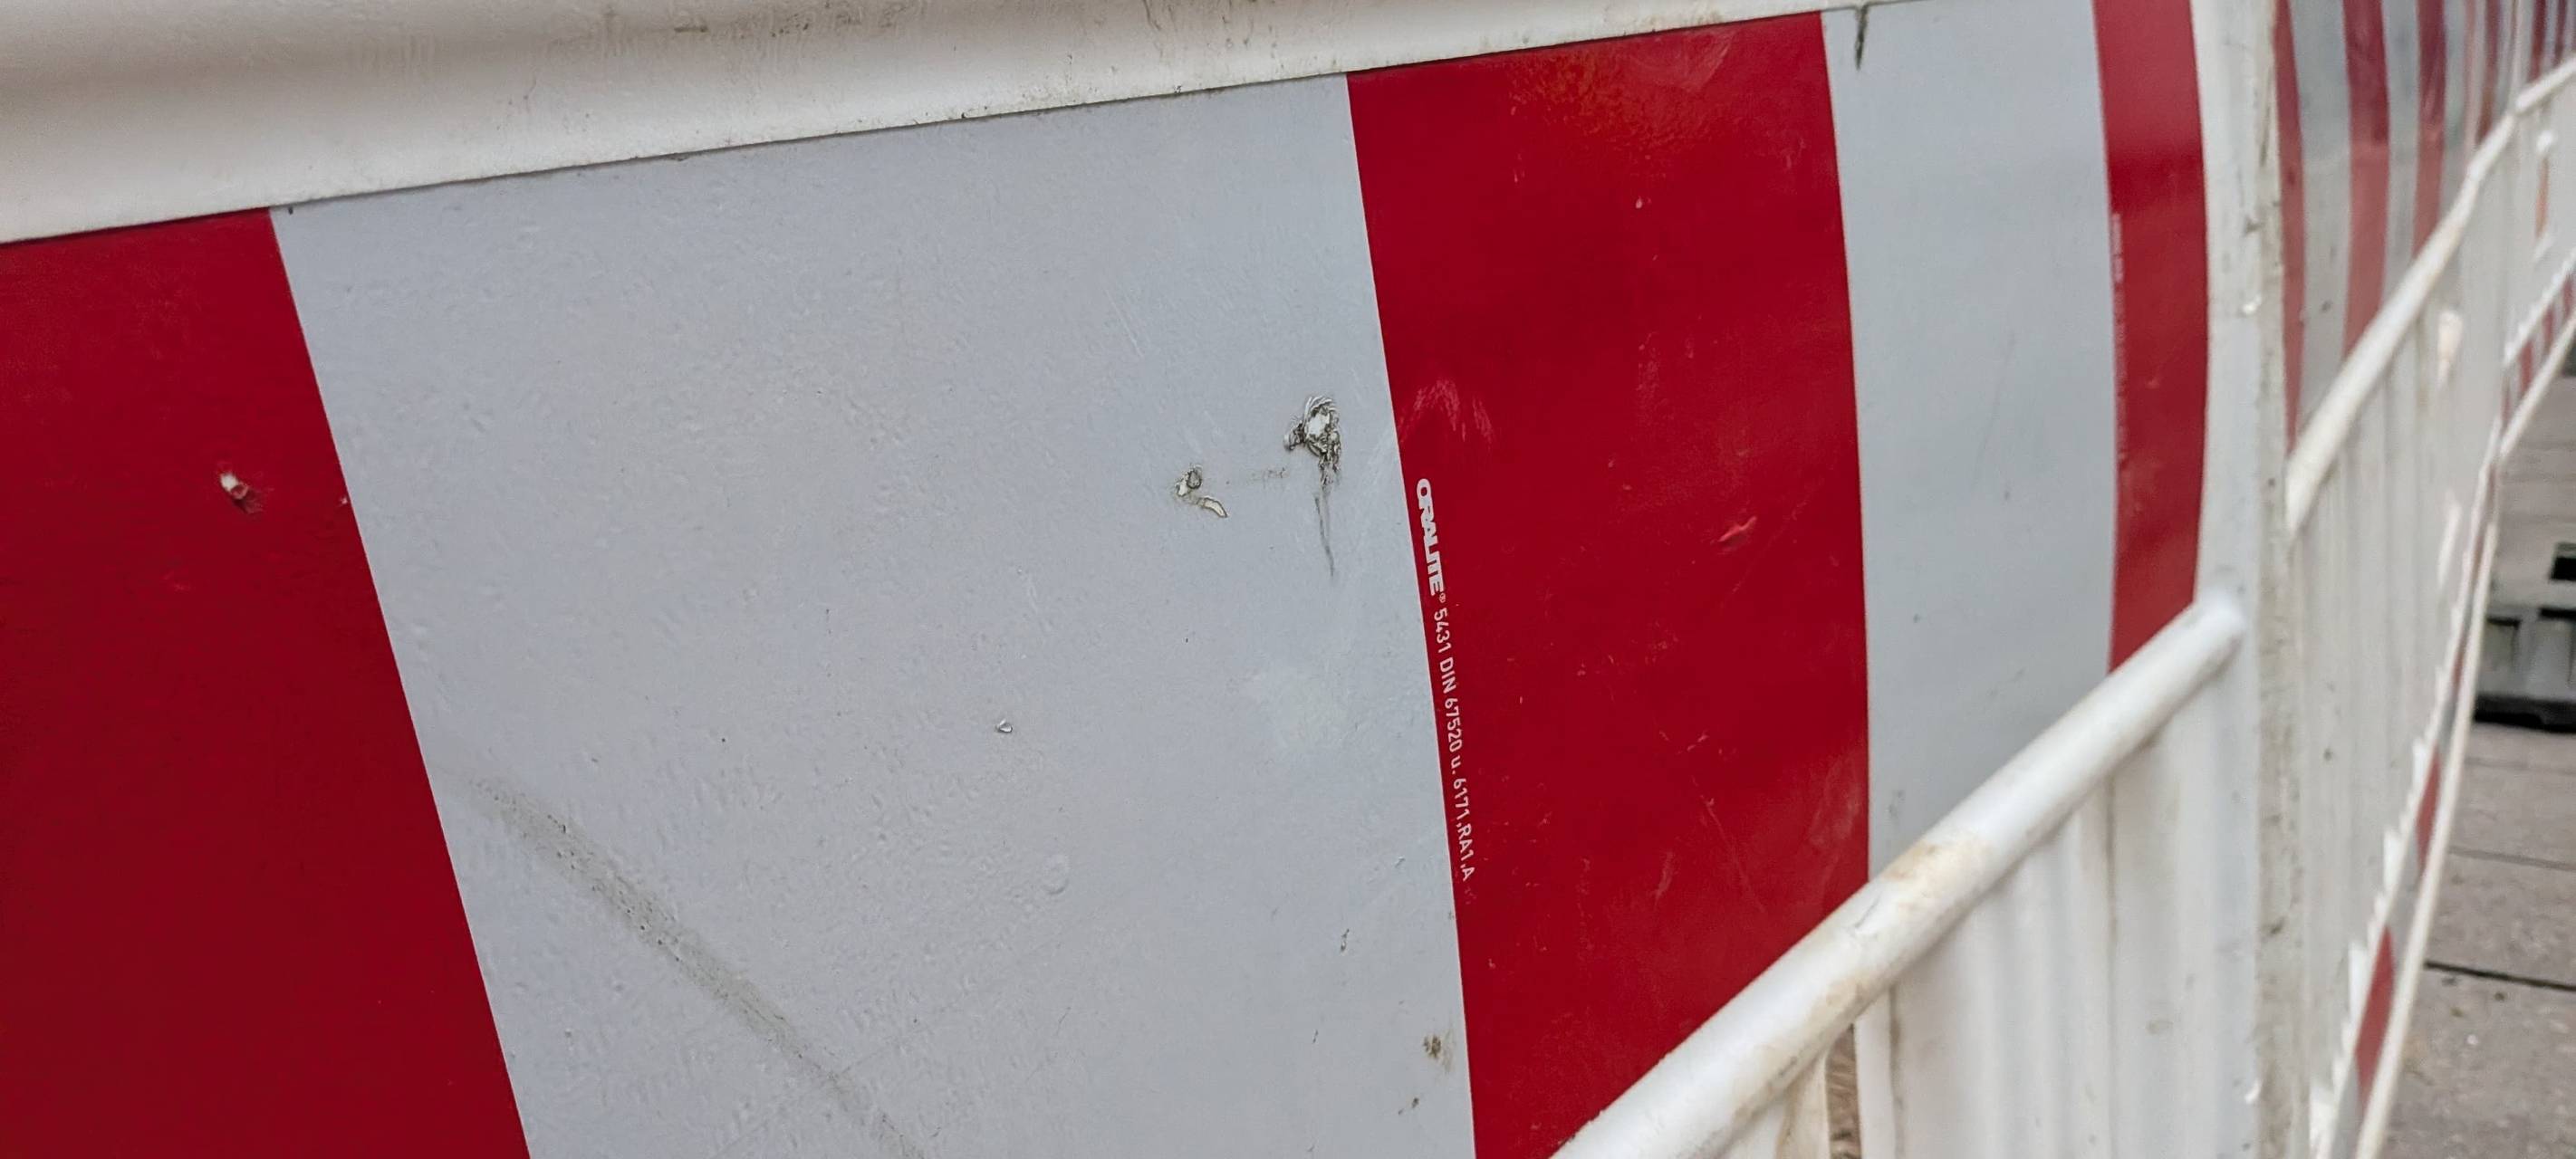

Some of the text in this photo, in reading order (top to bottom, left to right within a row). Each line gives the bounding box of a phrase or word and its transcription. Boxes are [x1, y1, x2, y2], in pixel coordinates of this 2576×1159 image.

[1434, 608, 1452, 654] 5431
[1439, 656, 1457, 694] DIN
[1445, 698, 1463, 753] 67520
[1450, 755, 1462, 775] u.
